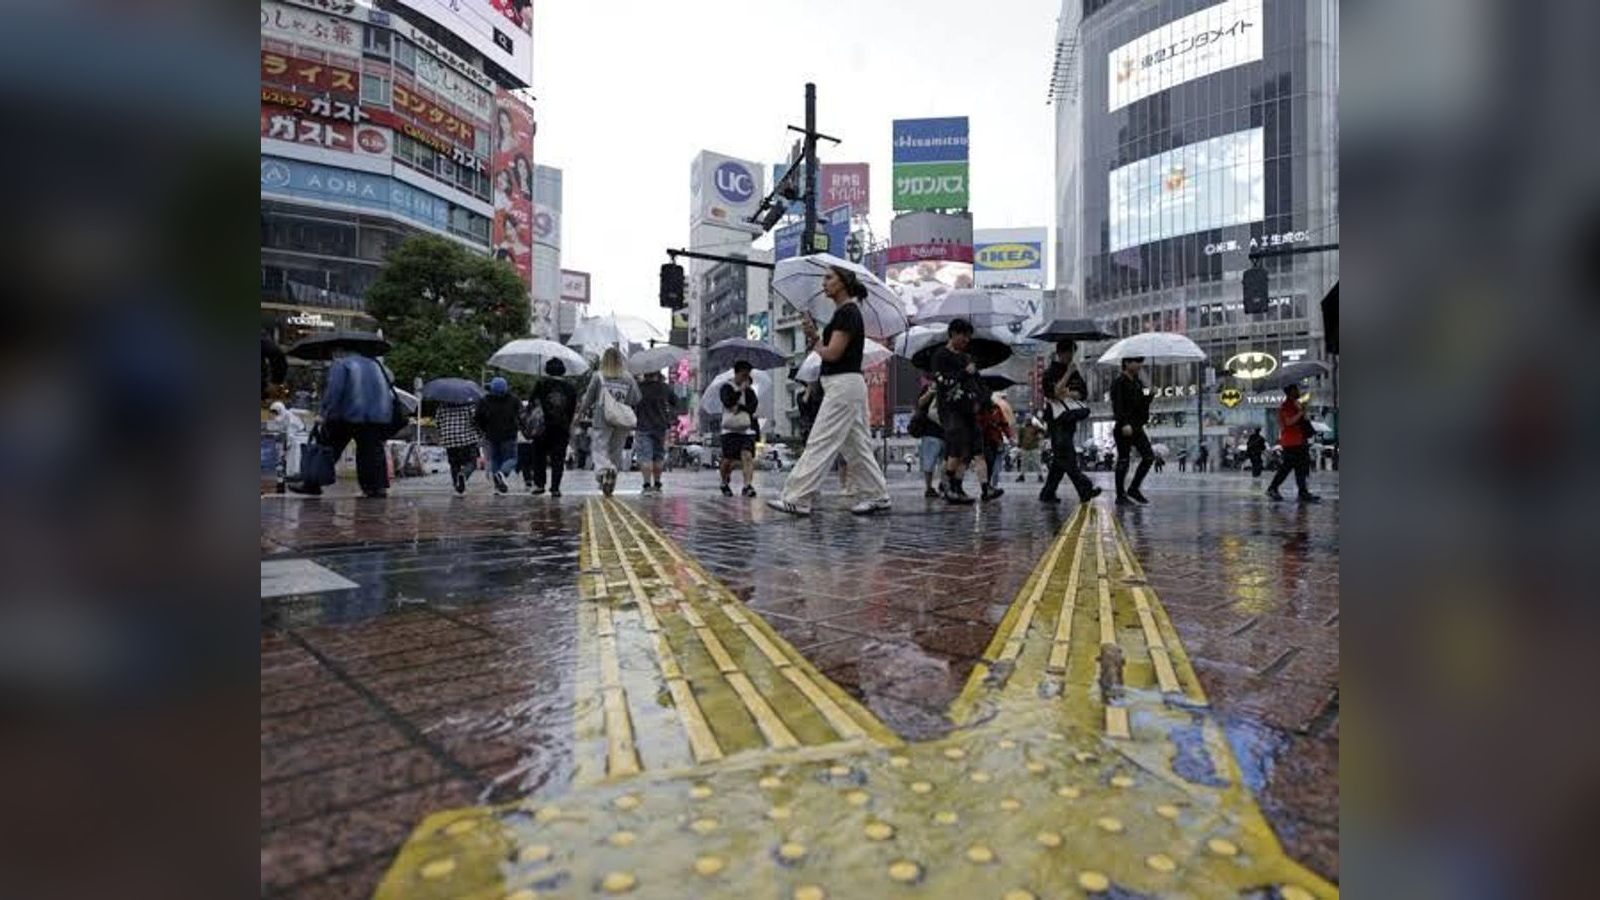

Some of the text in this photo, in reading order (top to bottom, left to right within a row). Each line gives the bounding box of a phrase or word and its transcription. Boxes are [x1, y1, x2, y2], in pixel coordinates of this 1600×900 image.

[264, 54, 355, 91] ライス
[310, 97, 370, 122] ガスト
[394, 84, 472, 139] コンタクト
[269, 115, 346, 146] ガスト
[308, 174, 376, 199] AOBA
[718, 168, 752, 196] UC
[898, 175, 964, 195] サロンパス
[981, 250, 1036, 262] IKEA
